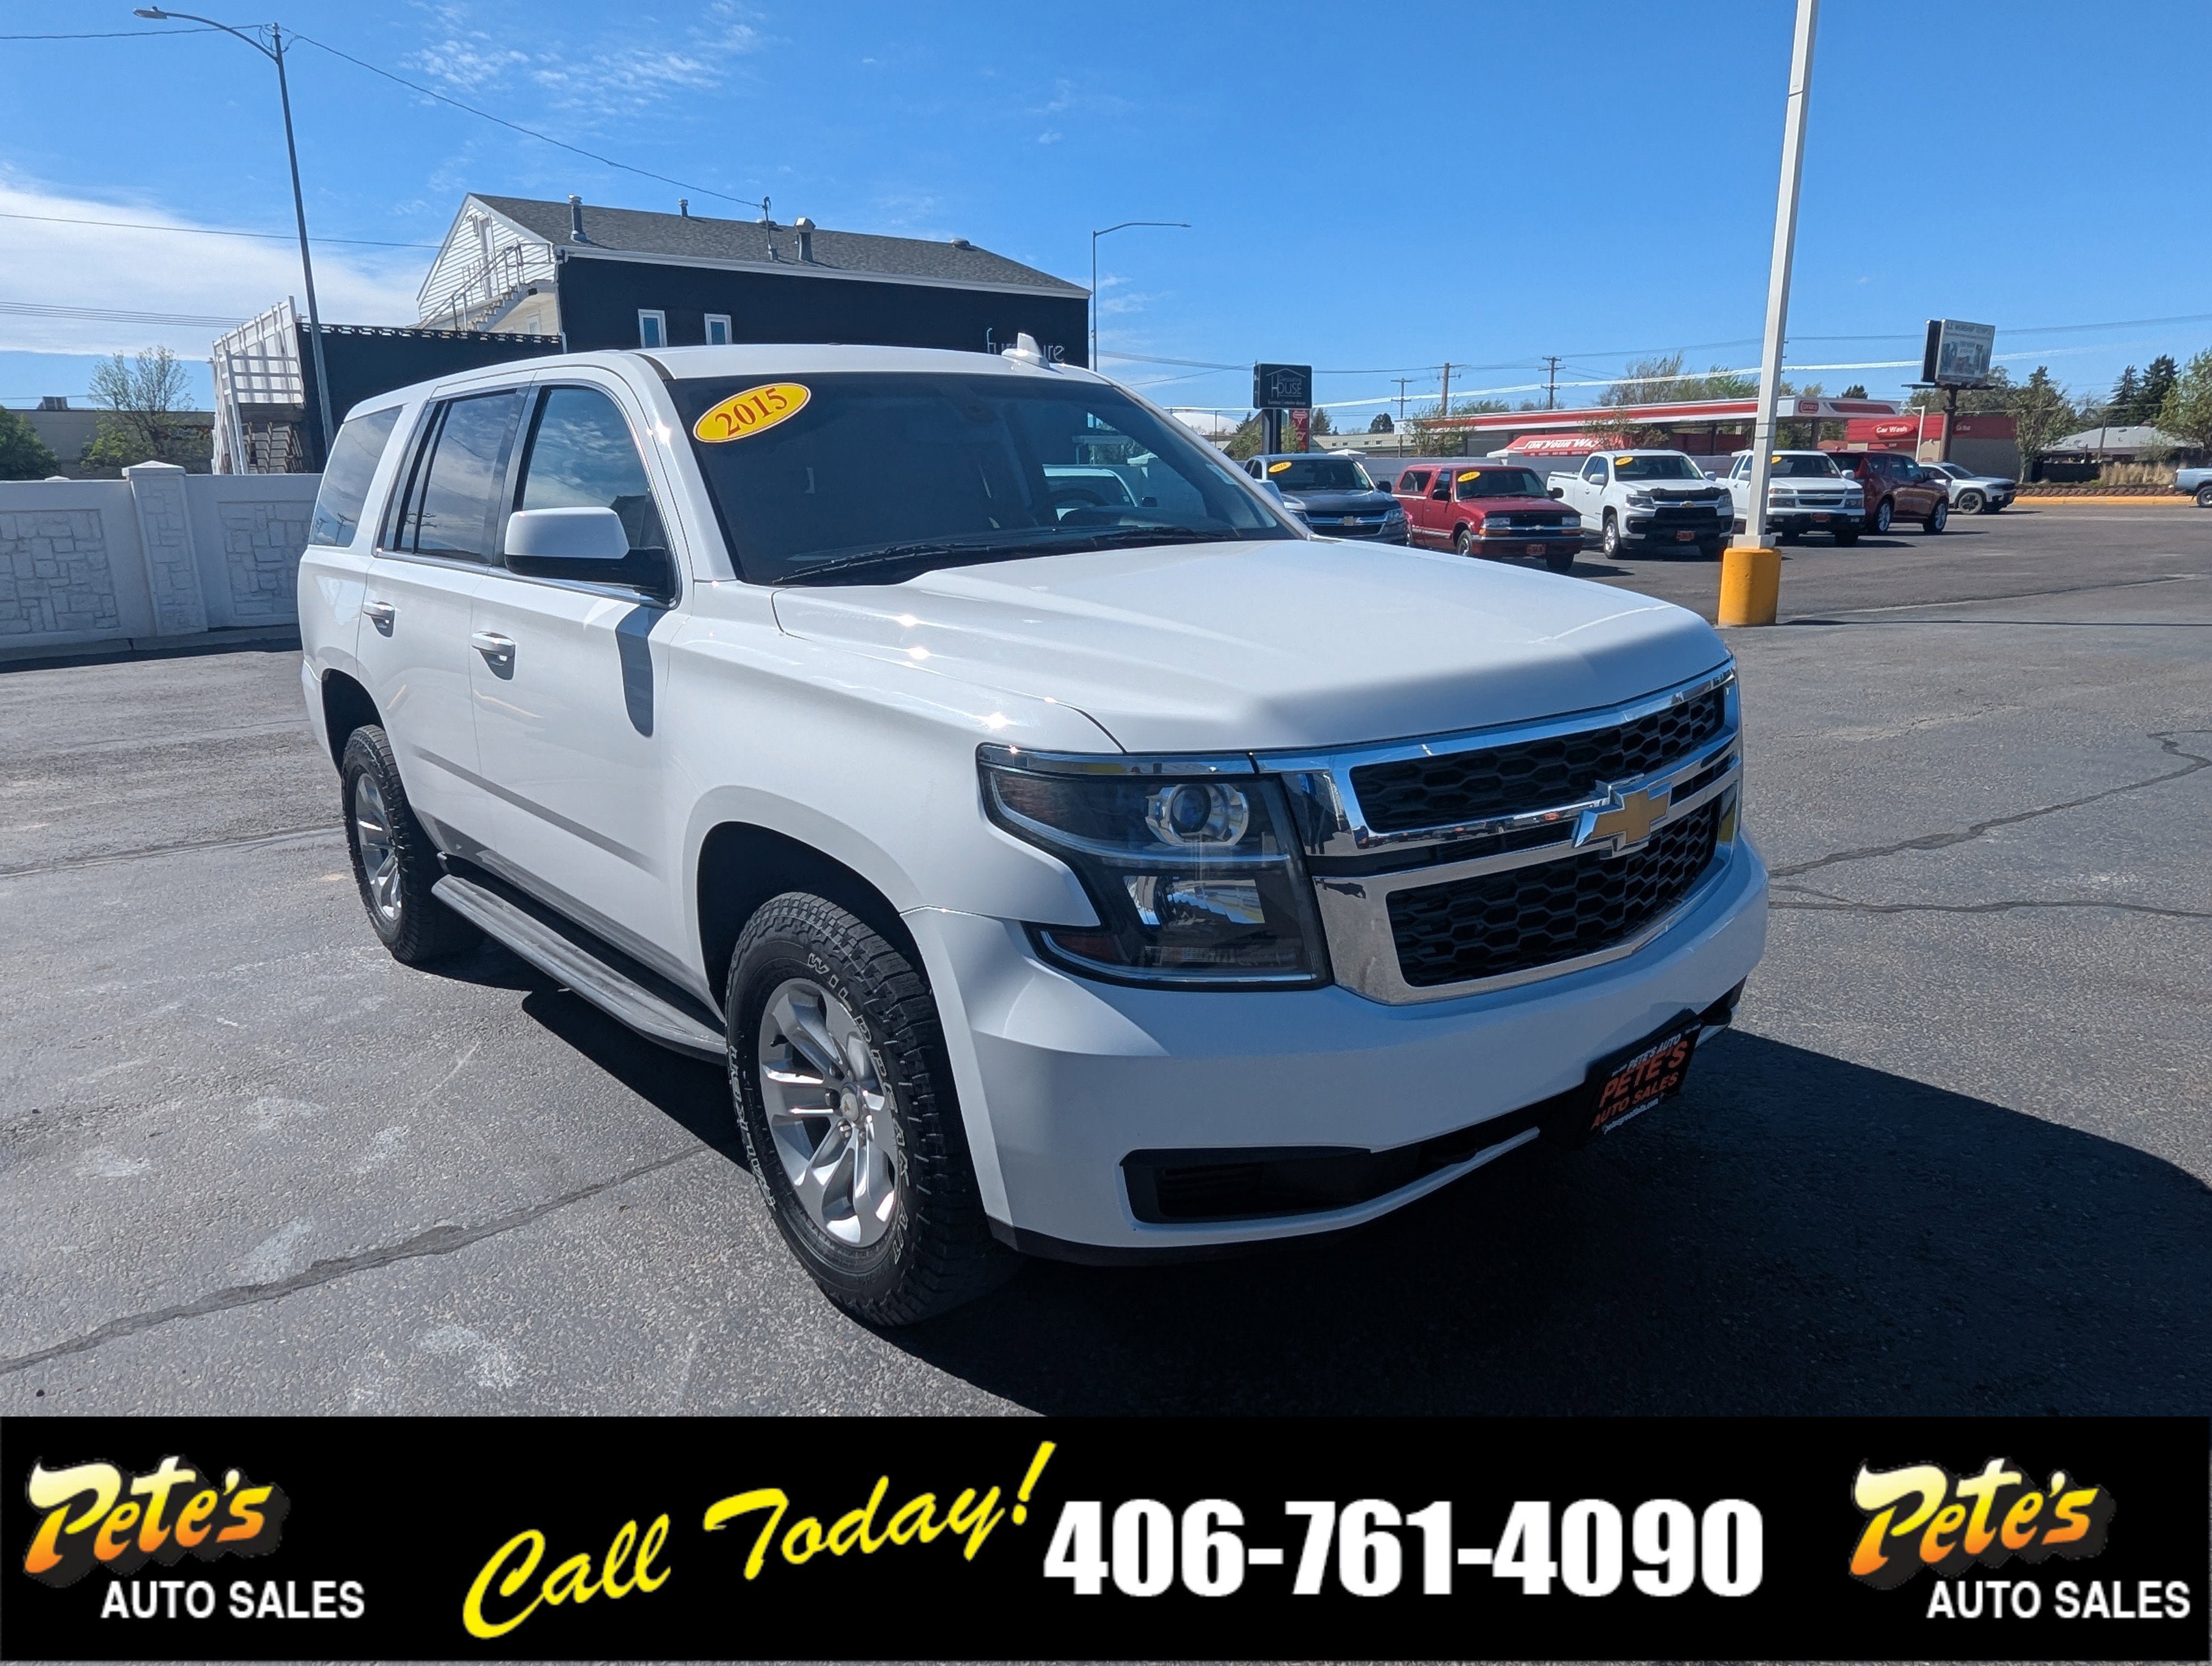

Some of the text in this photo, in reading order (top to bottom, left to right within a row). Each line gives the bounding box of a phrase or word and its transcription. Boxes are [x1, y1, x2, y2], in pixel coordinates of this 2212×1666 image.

[715, 387, 788, 437] 2015
[1542, 439, 1572, 450] YOUR
[1656, 1033, 1682, 1054] AUTO
[1598, 1039, 1689, 1108] PETE'S
[1590, 1096, 1630, 1131] AUTO
[1632, 1072, 1680, 1104] SALES
